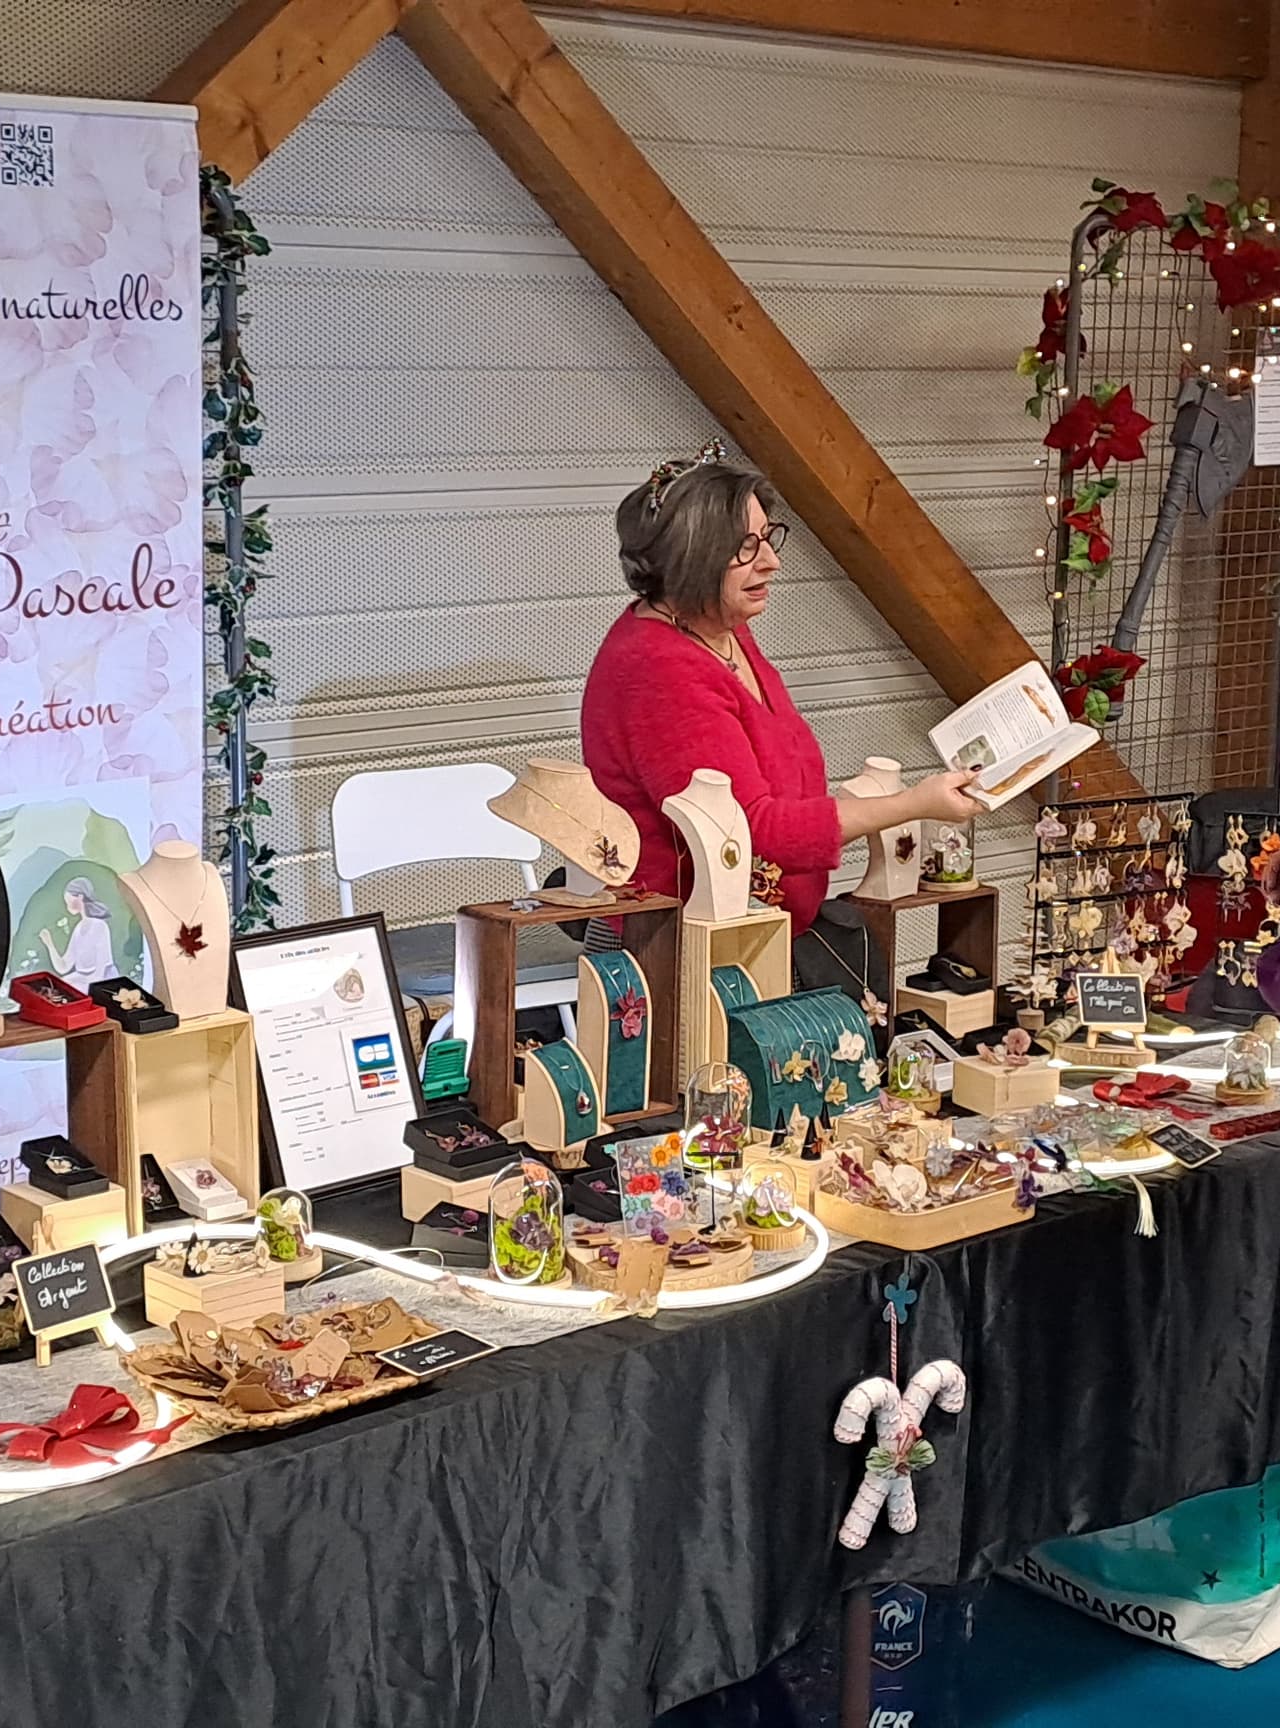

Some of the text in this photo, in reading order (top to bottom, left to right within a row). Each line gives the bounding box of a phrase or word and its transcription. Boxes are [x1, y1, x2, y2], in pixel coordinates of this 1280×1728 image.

[1, 273, 184, 323] naturelles
[27, 1257, 85, 1284] Collection
[1014, 1556, 1177, 1641] ENTRAKOR
[874, 1641, 914, 1652] FRANCE
